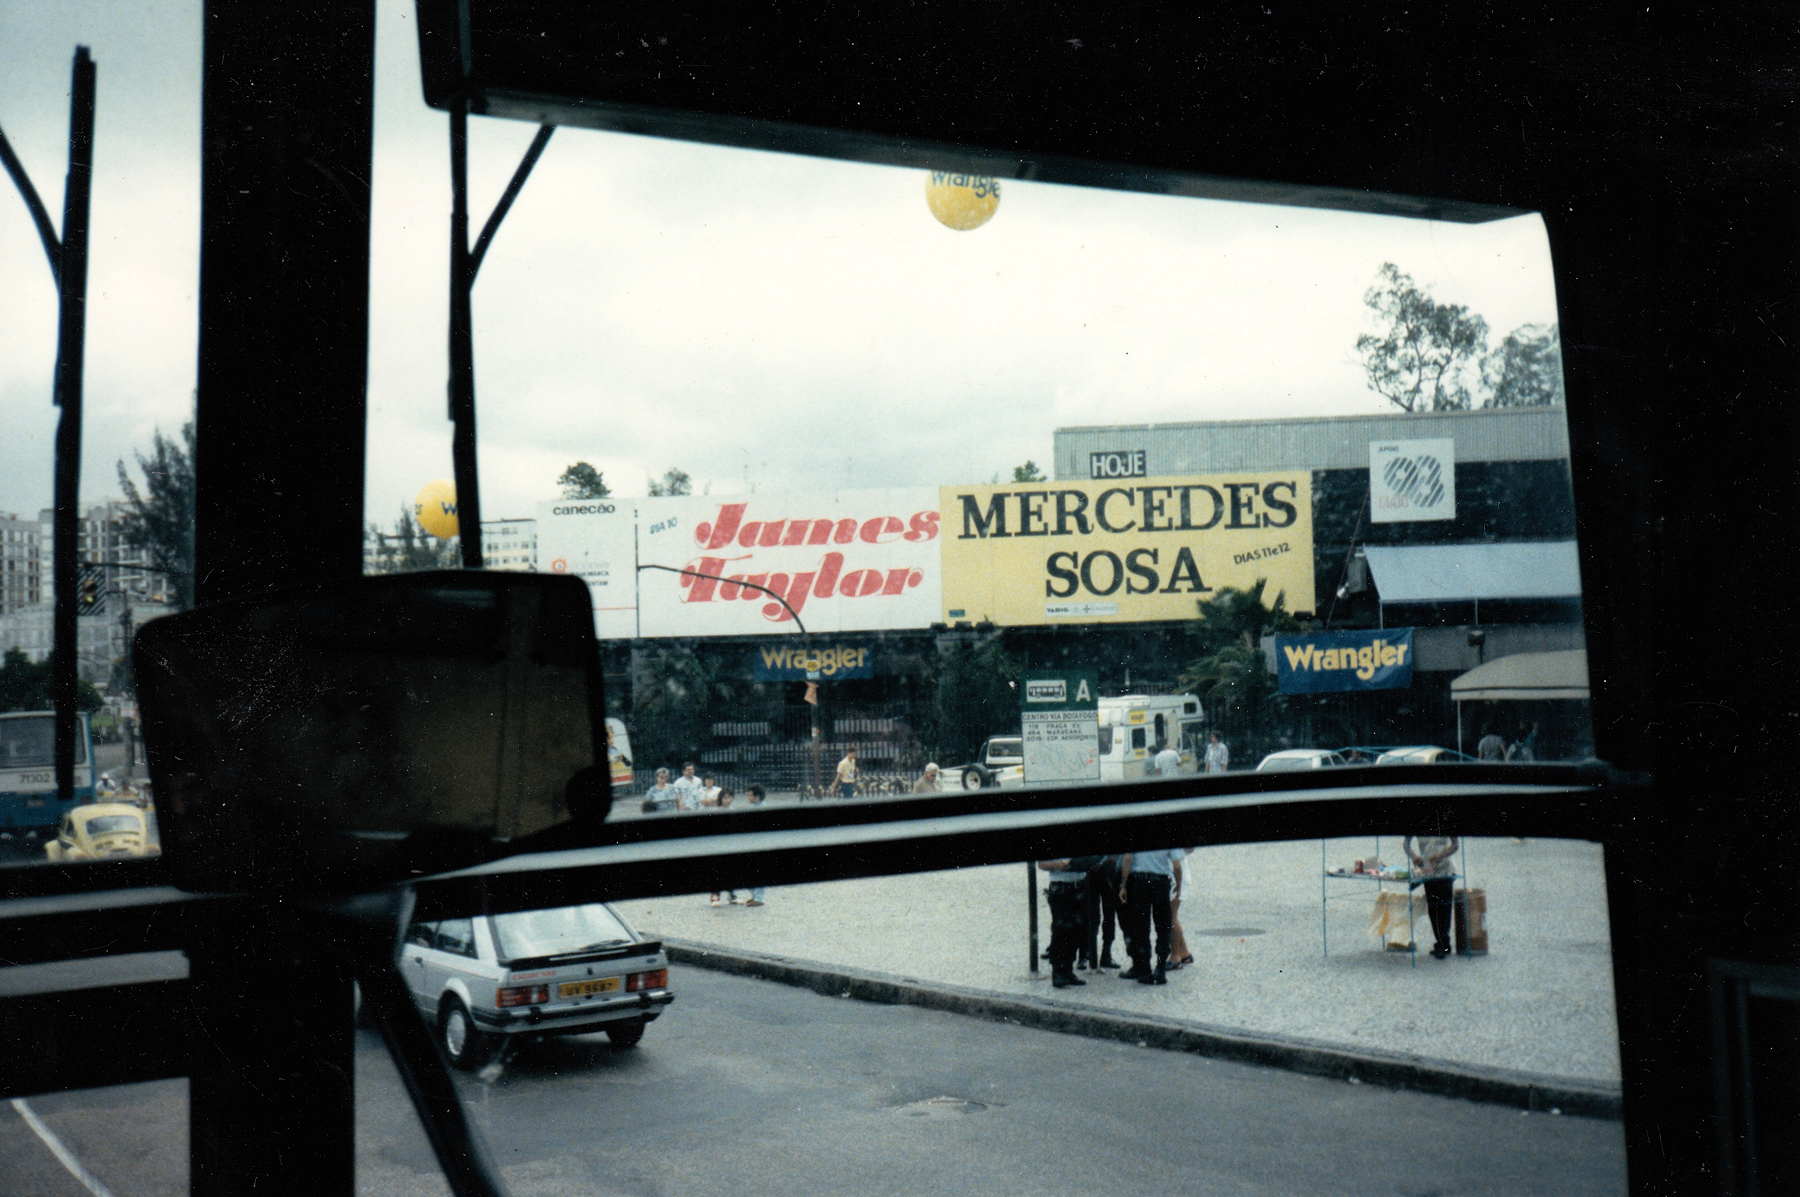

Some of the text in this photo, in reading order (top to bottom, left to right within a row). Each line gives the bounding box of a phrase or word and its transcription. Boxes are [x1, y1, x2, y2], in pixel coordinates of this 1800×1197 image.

[1092, 453, 1145, 477] HOJE
[695, 502, 941, 550] James
[957, 480, 1297, 539] MERCEDES
[680, 551, 924, 622] Taylor
[1046, 546, 1212, 598] SOSA
[1284, 639, 1408, 681] Wrangler
[1075, 679, 1091, 702] A
